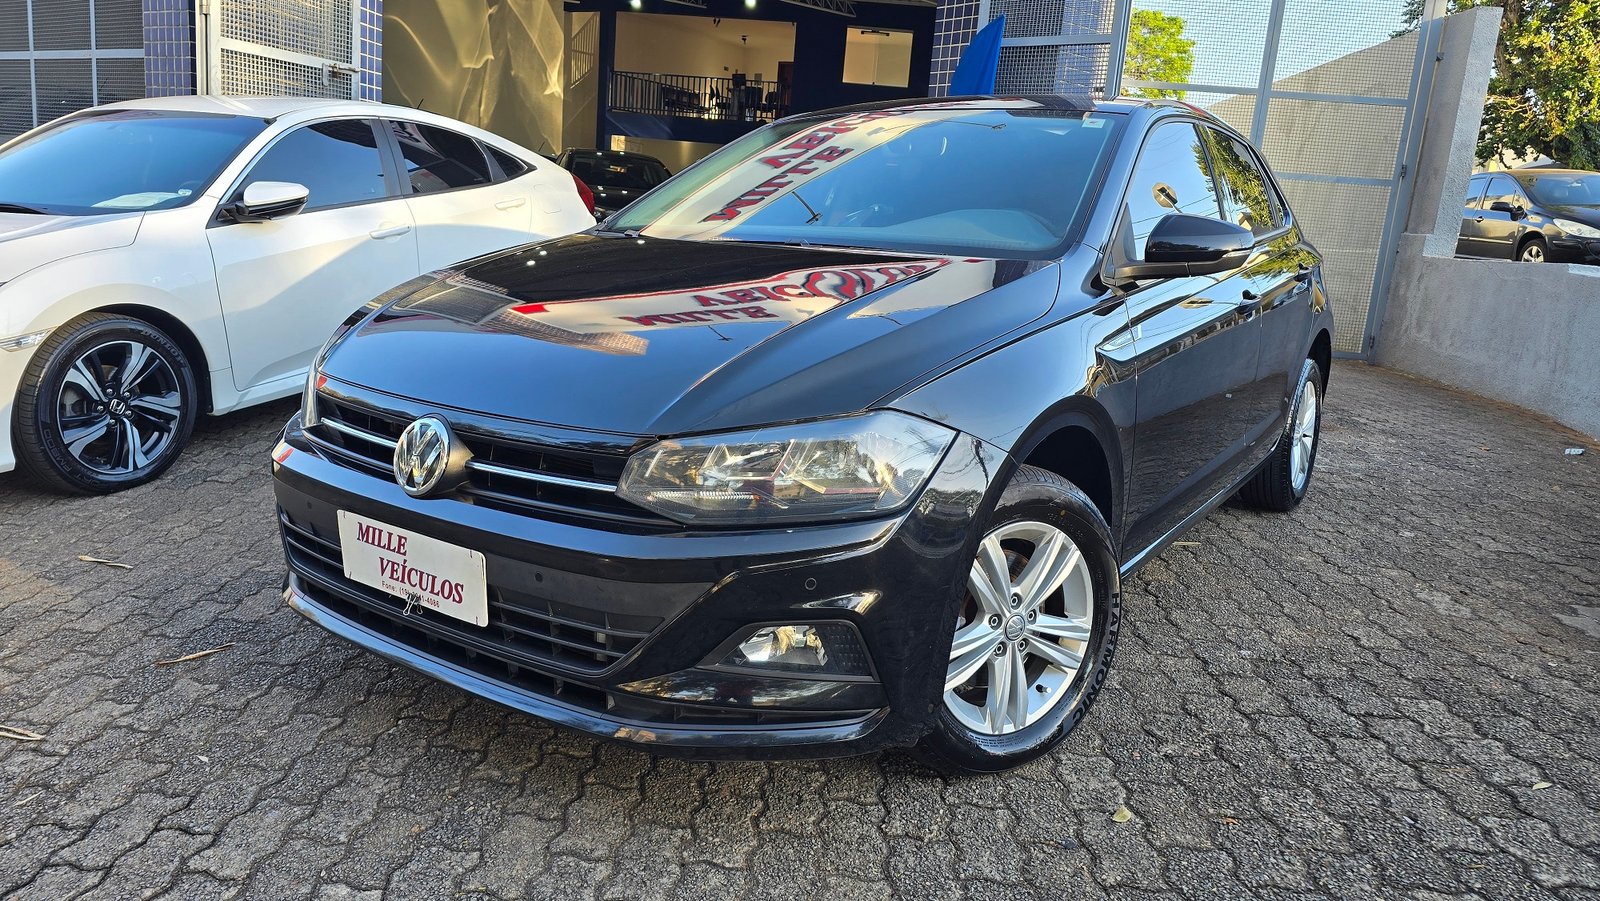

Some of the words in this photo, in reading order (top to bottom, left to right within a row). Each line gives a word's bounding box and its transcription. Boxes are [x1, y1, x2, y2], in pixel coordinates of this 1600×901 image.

[356, 521, 408, 557] MILLE
[378, 555, 465, 605] VEÍCULOS
[1073, 593, 1120, 725] HARMONIC
